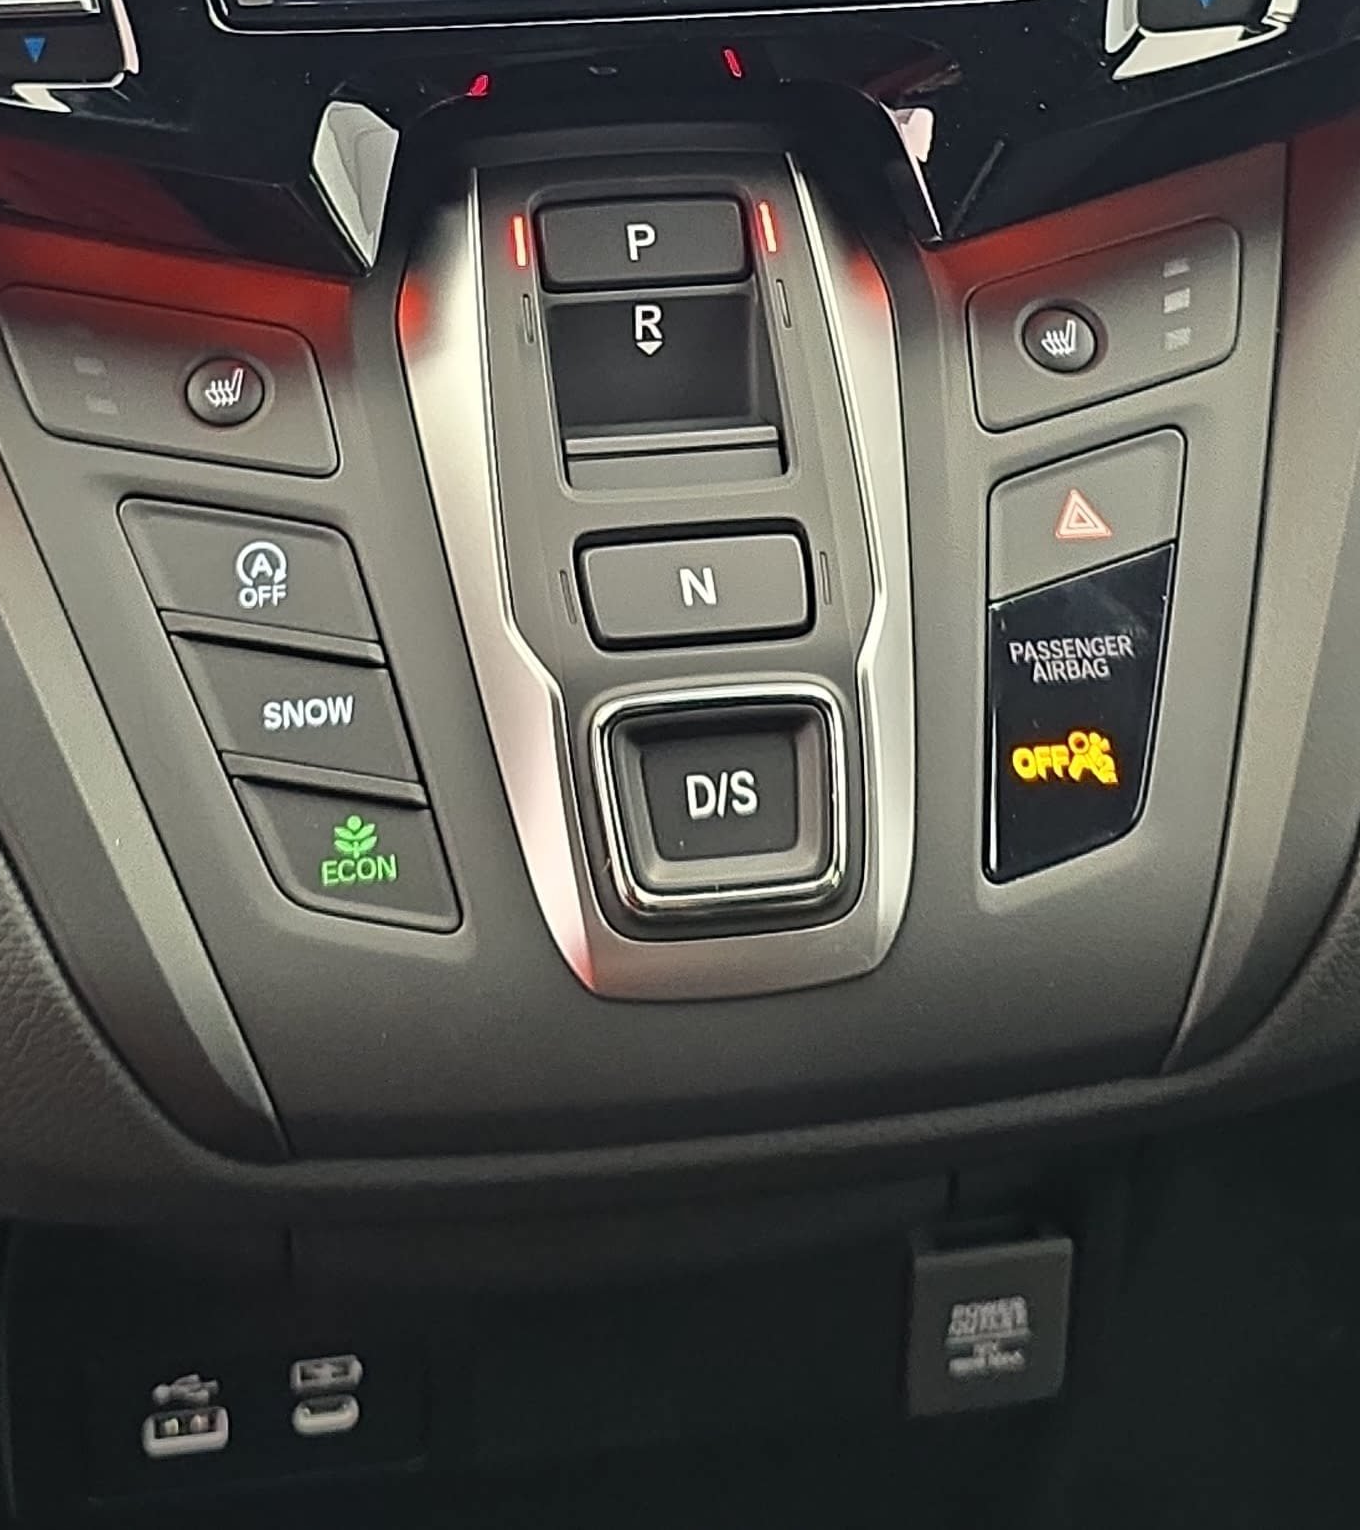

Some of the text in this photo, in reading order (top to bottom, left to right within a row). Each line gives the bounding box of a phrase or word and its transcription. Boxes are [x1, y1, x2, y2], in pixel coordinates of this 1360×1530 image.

[626, 223, 656, 261] P
[634, 304, 663, 341] R
[239, 584, 287, 608] OFF
[680, 567, 717, 606] N
[1009, 634, 1135, 664] PASSENGER
[1032, 658, 1110, 683] AIRBAG
[263, 696, 354, 730] SNOW
[1012, 744, 1070, 781] OFF
[685, 770, 758, 820] D/S
[321, 854, 398, 886] ECON
